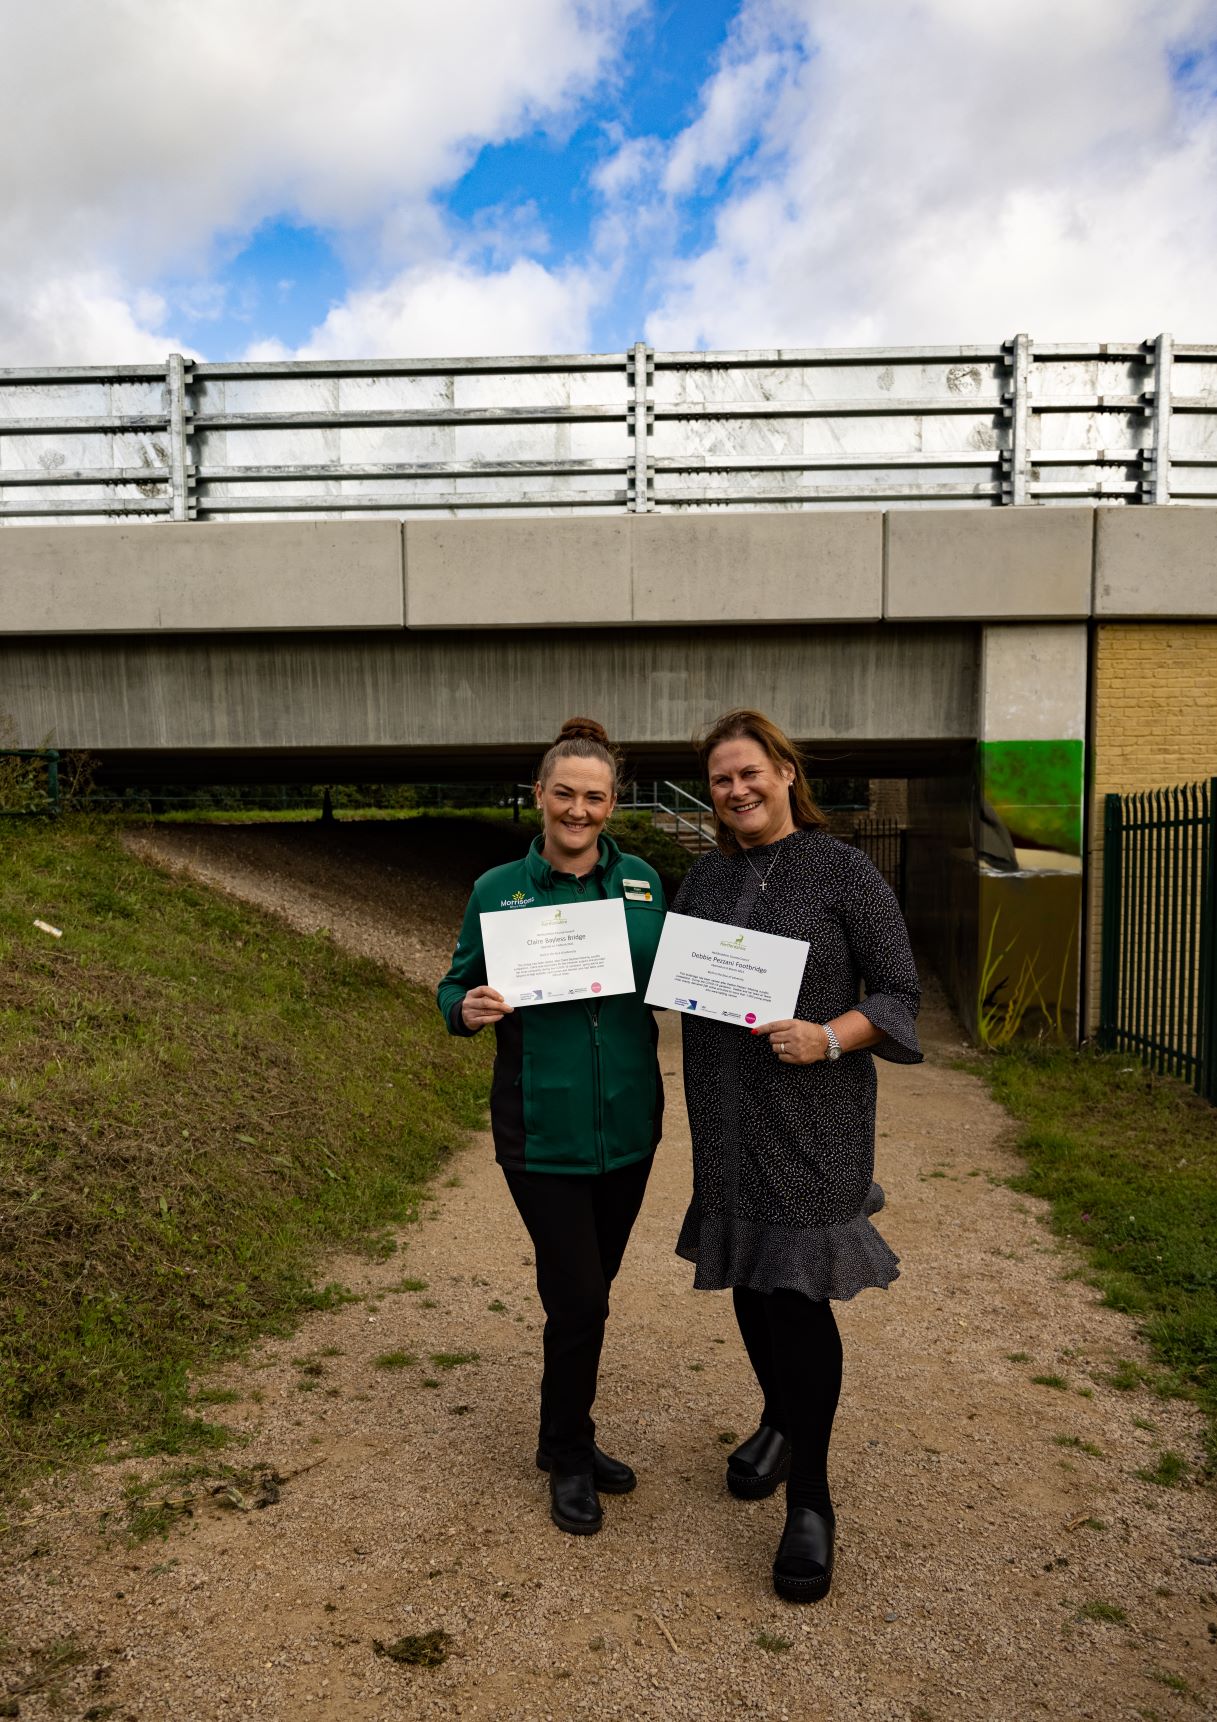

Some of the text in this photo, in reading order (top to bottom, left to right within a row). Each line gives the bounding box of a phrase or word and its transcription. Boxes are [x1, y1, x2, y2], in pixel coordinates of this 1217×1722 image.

[501, 897, 535, 907] Morrisons
[526, 938, 544, 946] Claire
[567, 933, 586, 942] Bridge
[691, 951, 711, 962] Debbie
[735, 961, 767, 974] Footbridge
